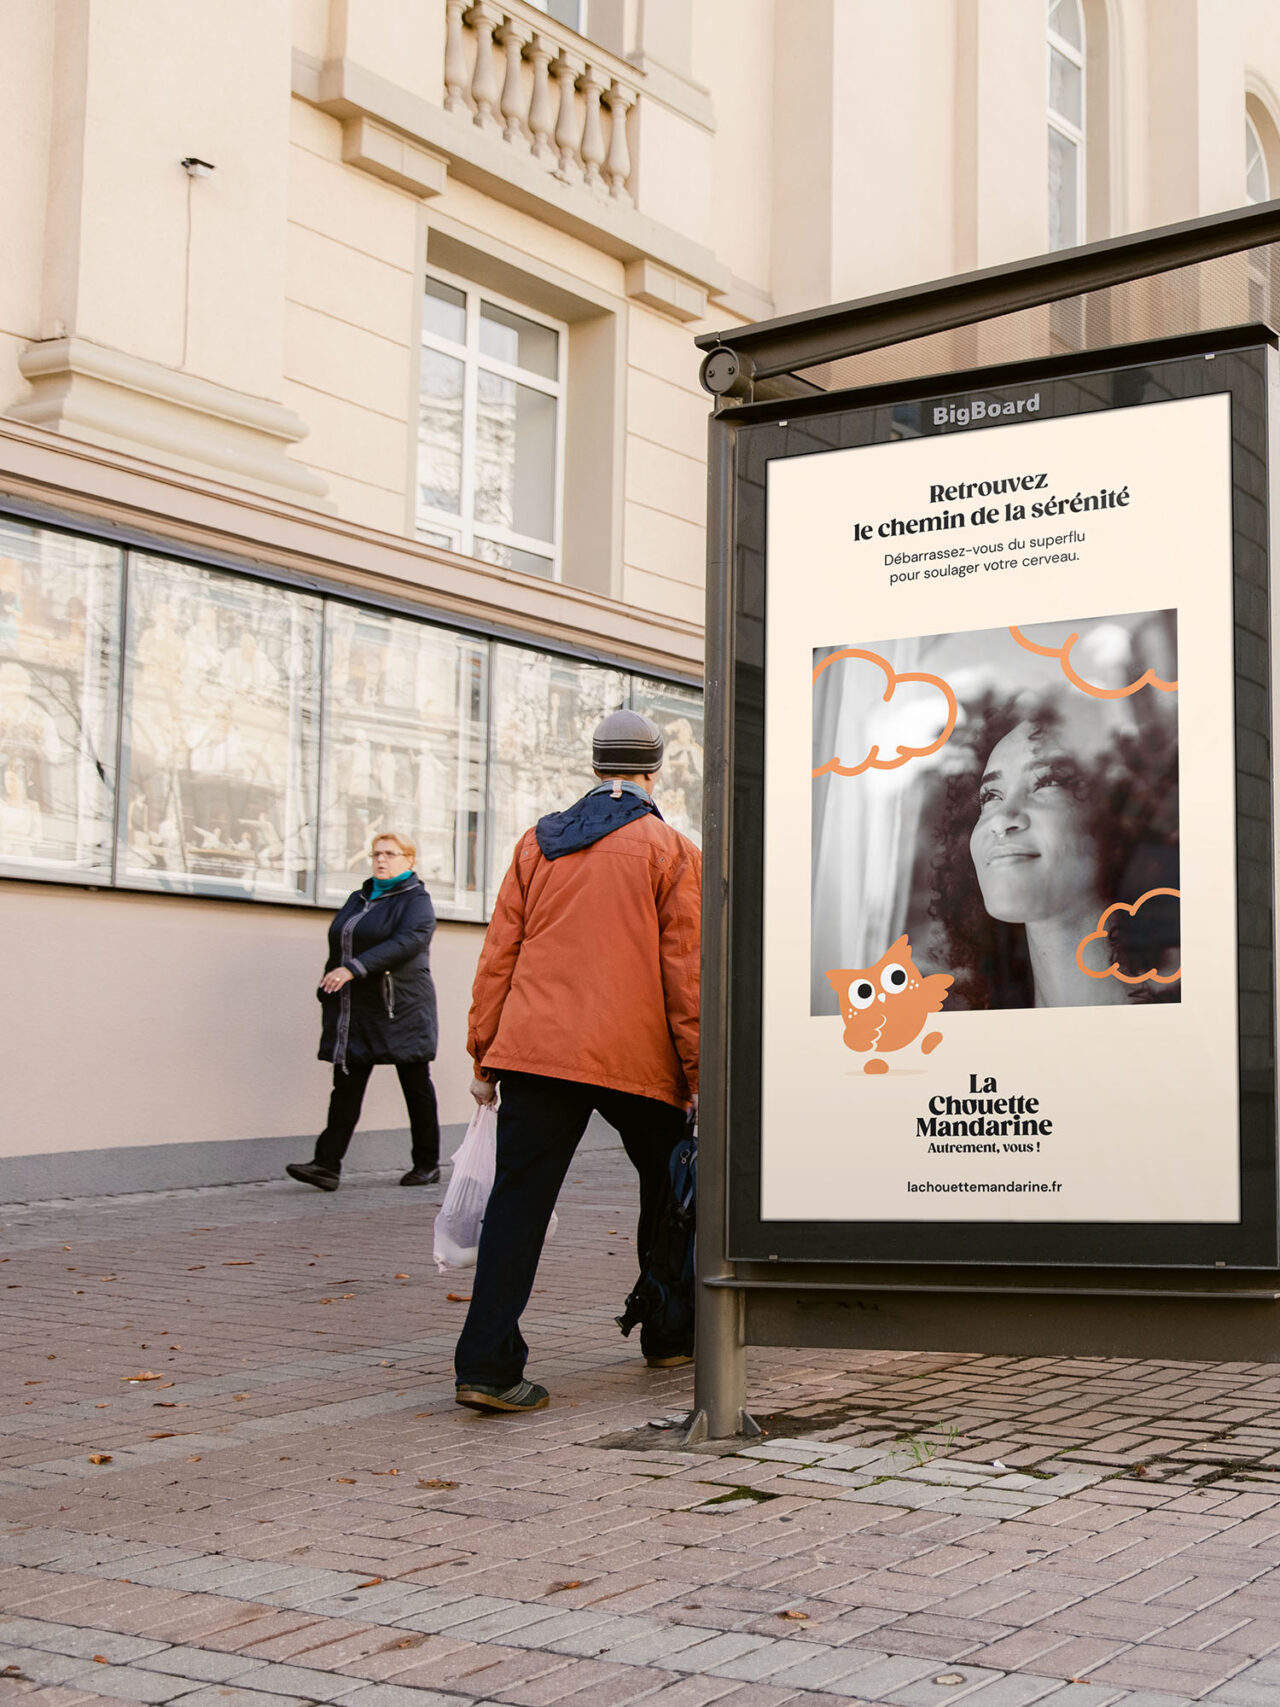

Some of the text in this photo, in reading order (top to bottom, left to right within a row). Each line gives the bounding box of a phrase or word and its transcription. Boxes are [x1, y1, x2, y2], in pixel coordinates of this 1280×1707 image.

[933, 393, 1040, 425] BigBoard
[929, 473, 1049, 504] Retrouvez
[854, 485, 1130, 542] le chemin de la sérénité
[884, 530, 1085, 566] Débarrassez-vous du superflu
[889, 552, 1080, 586] pour soulager votre cerveau.
[969, 1073, 998, 1094] La
[928, 1095, 1040, 1116] Chouette
[915, 1114, 1053, 1138] Mandarine
[927, 1142, 1001, 1155] Autrement,
[1003, 1143, 1034, 1153] vous
[907, 1180, 1063, 1193] lachouettemandarine.fr
